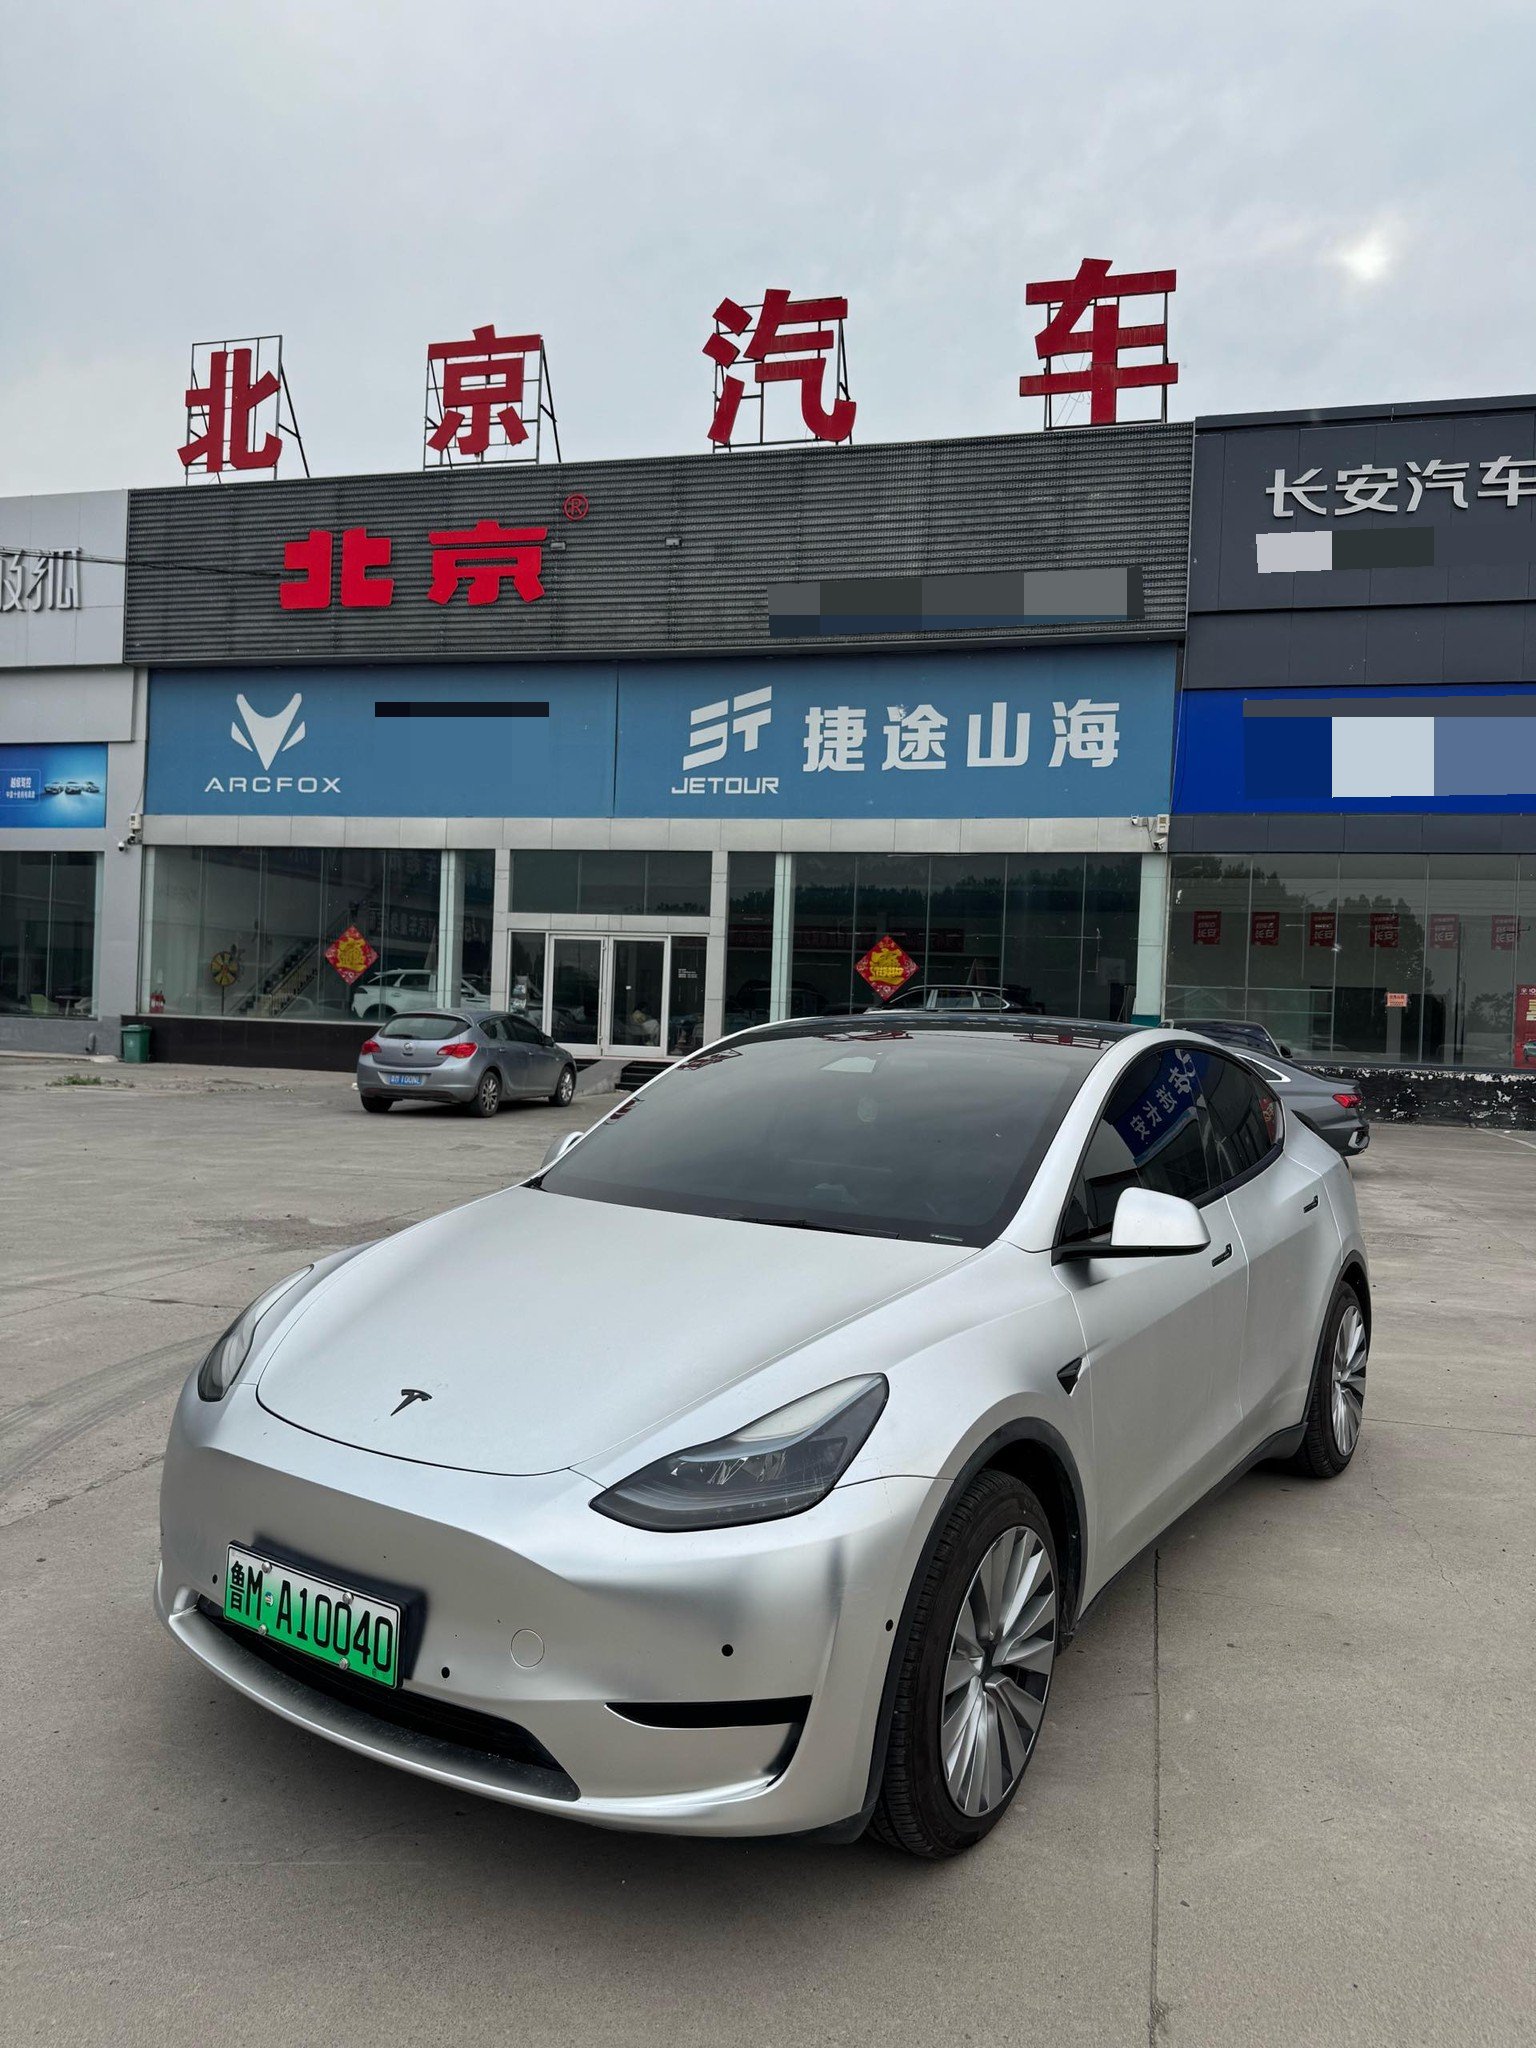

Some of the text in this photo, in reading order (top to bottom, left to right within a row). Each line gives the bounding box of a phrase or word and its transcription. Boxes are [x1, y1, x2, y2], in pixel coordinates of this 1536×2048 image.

[178, 258, 1179, 472] 北京汽车
[1265, 456, 1536, 517] 长安汽车
[279, 519, 547, 609] 北京
[803, 699, 1120, 772] 捷途山海
[204, 777, 341, 793] ARCFOX
[671, 777, 779, 794] JETOUR
